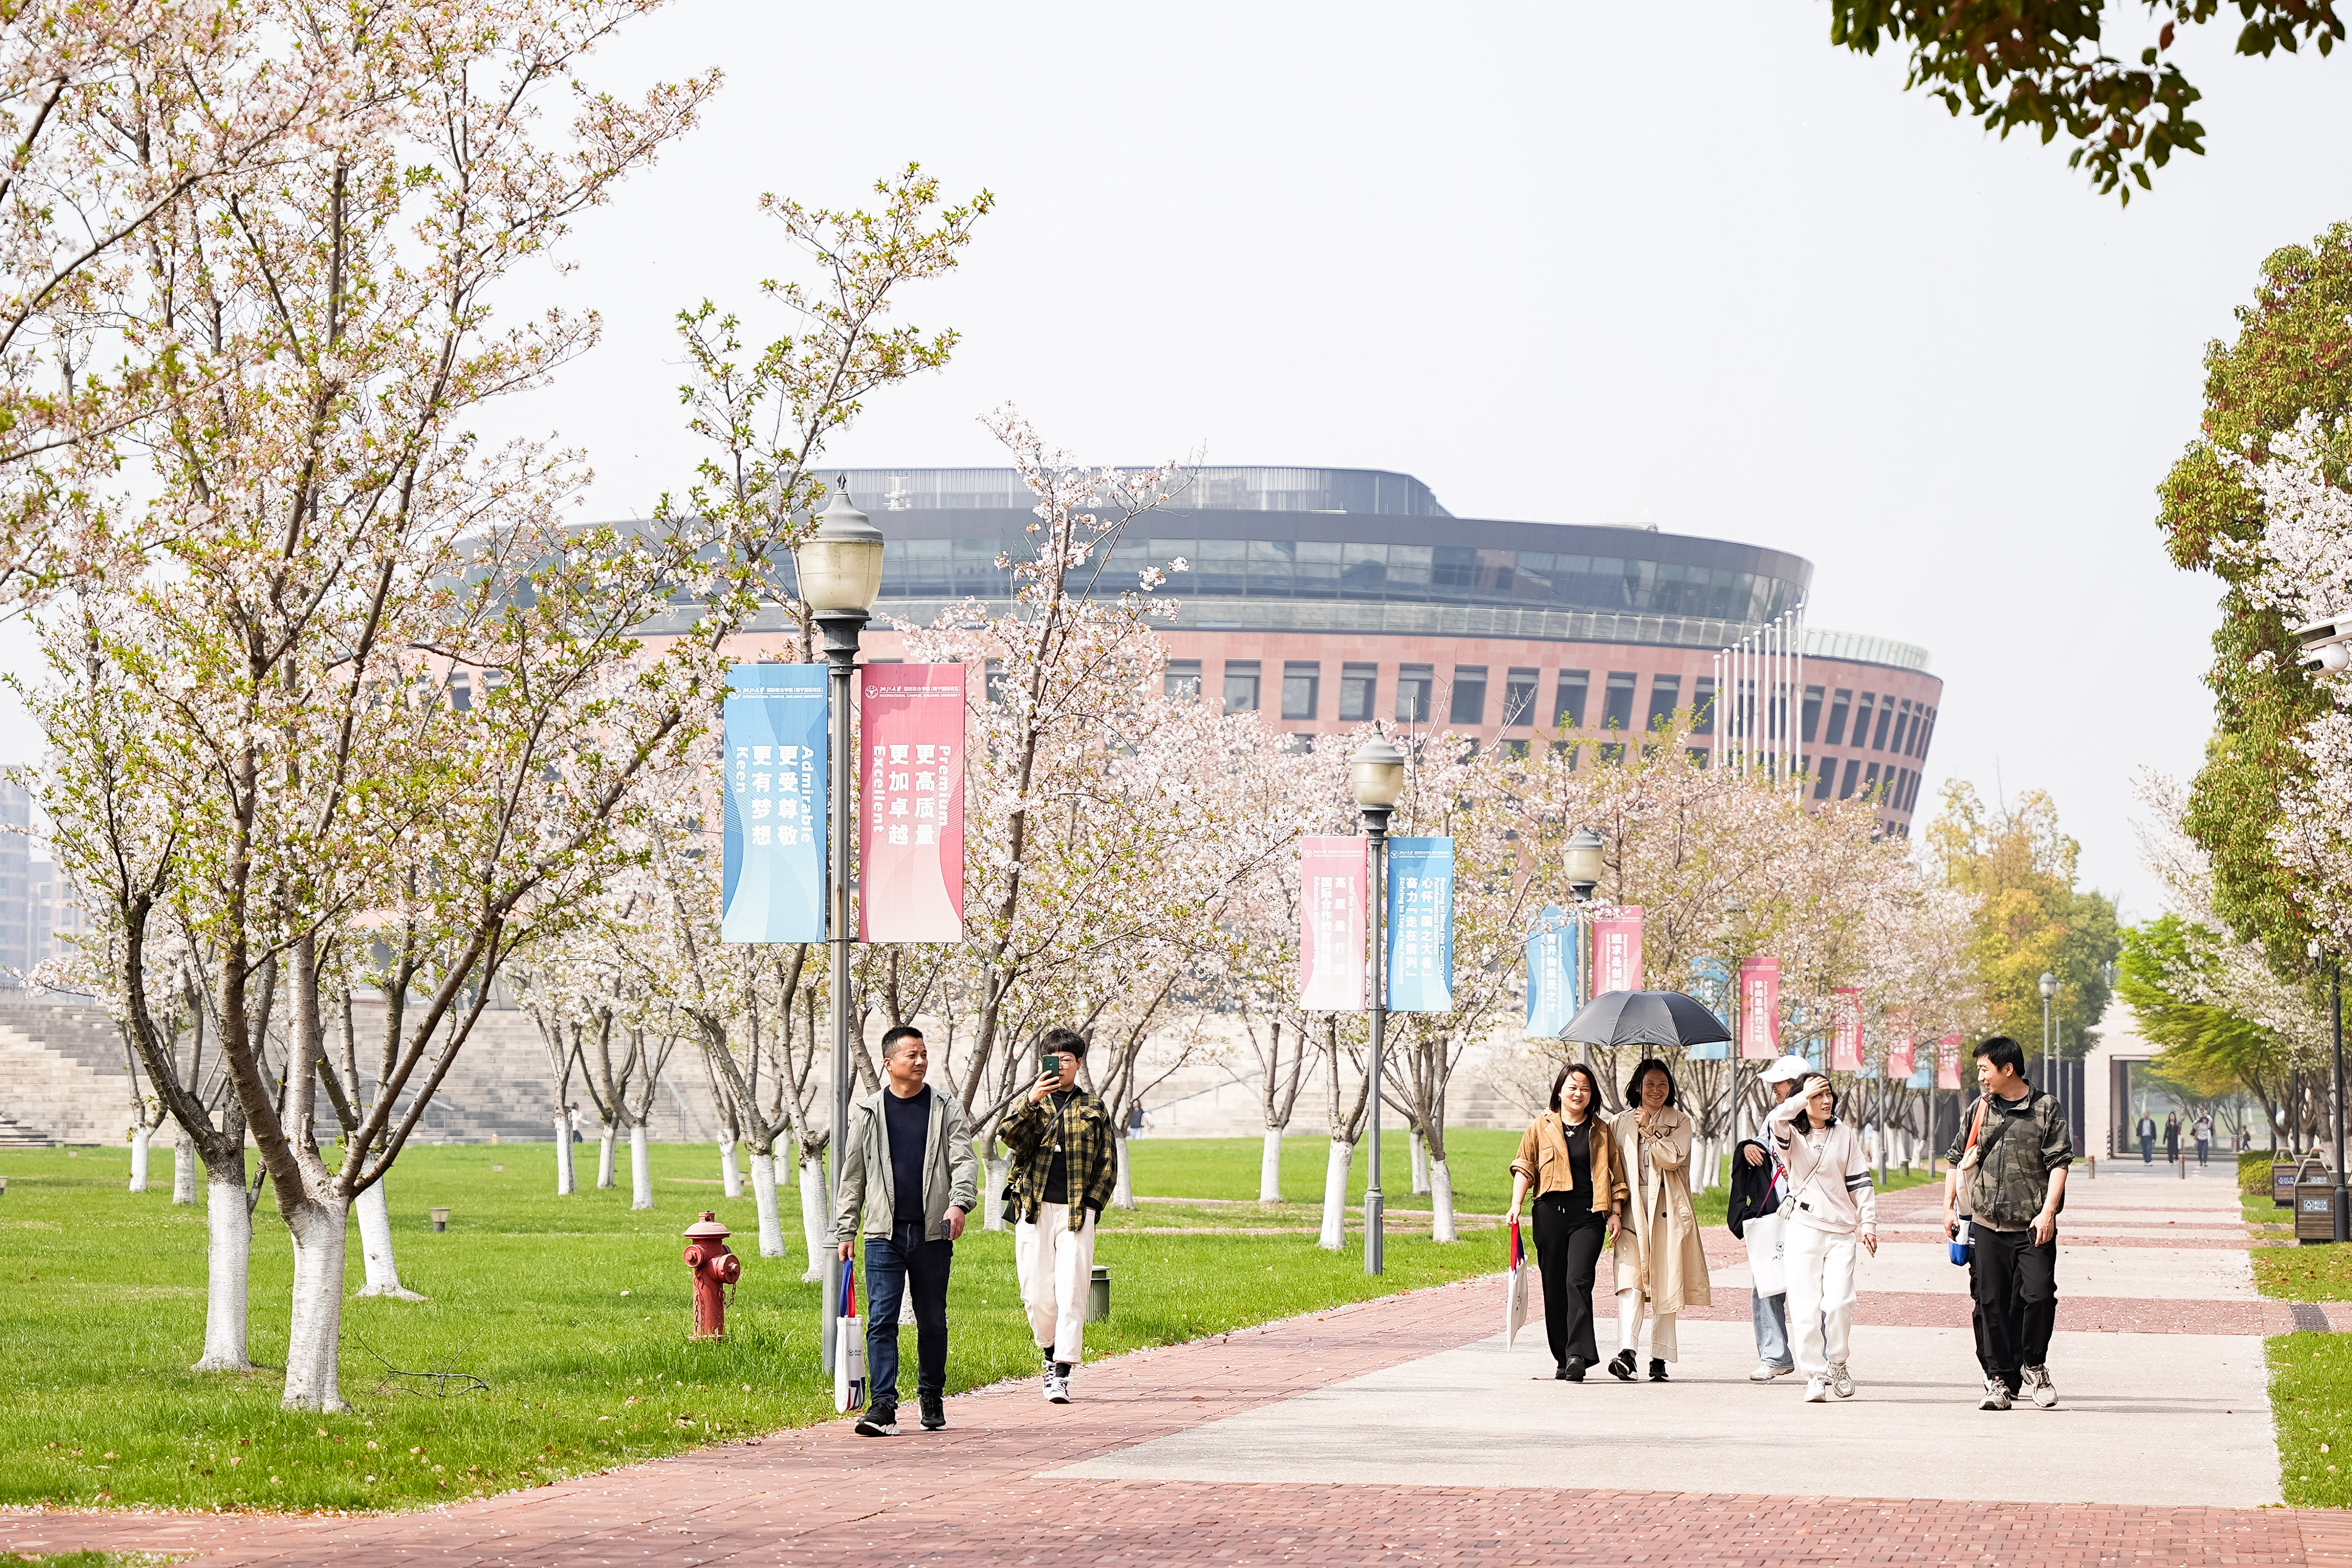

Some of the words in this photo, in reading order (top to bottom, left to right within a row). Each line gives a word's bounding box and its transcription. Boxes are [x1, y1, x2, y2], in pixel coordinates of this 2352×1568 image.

[736, 746, 748, 793] Keen
[751, 745, 773, 846] 更有梦想
[778, 745, 799, 846] 更受尊敬
[801, 745, 814, 843] Admirable
[873, 745, 886, 832] Excellent
[889, 744, 909, 845] 更加卓越
[915, 744, 936, 845] 更高质量
[938, 745, 951, 826] Premium
